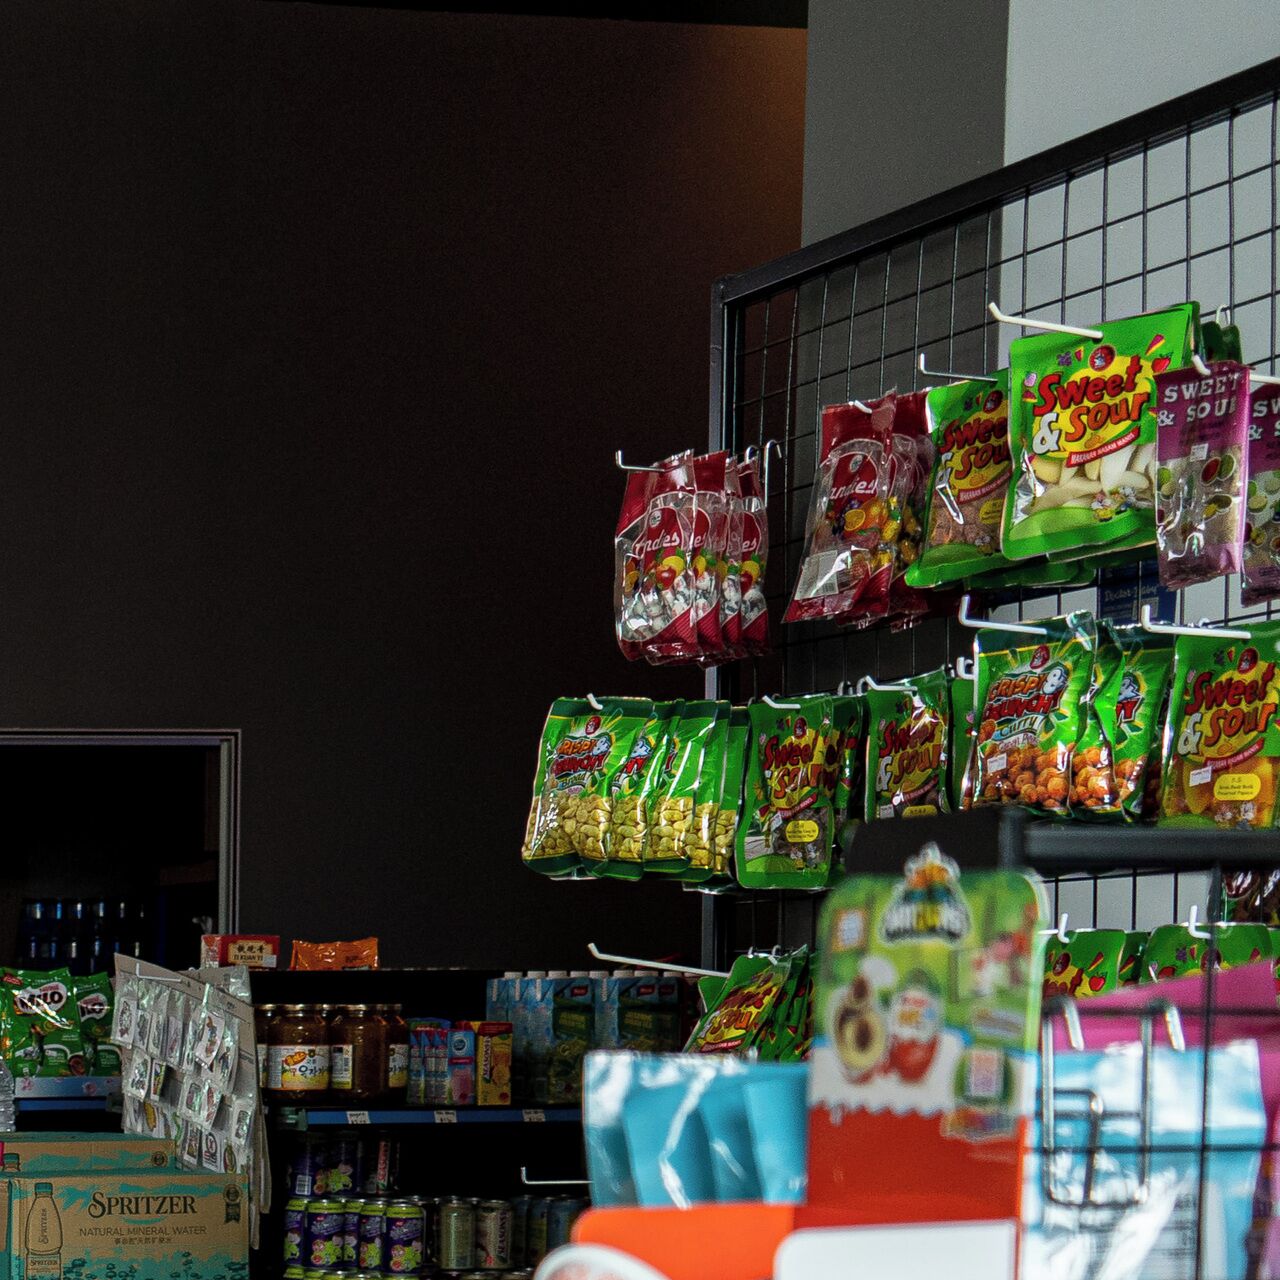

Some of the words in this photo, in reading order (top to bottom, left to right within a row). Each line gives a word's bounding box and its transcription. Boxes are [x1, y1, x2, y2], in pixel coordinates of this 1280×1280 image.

[1034, 354, 1145, 416] Sweet
[1164, 372, 1241, 403] SWEET
[1032, 413, 1060, 455] &
[1158, 410, 1175, 426] &
[1186, 664, 1276, 714] Sweet
[1178, 712, 1202, 755] &
[88, 1192, 197, 1218] SPRITZER
[79, 1227, 124, 1237] NATURAL
[126, 1226, 171, 1236] MINERAL
[173, 1226, 207, 1235] WATER
